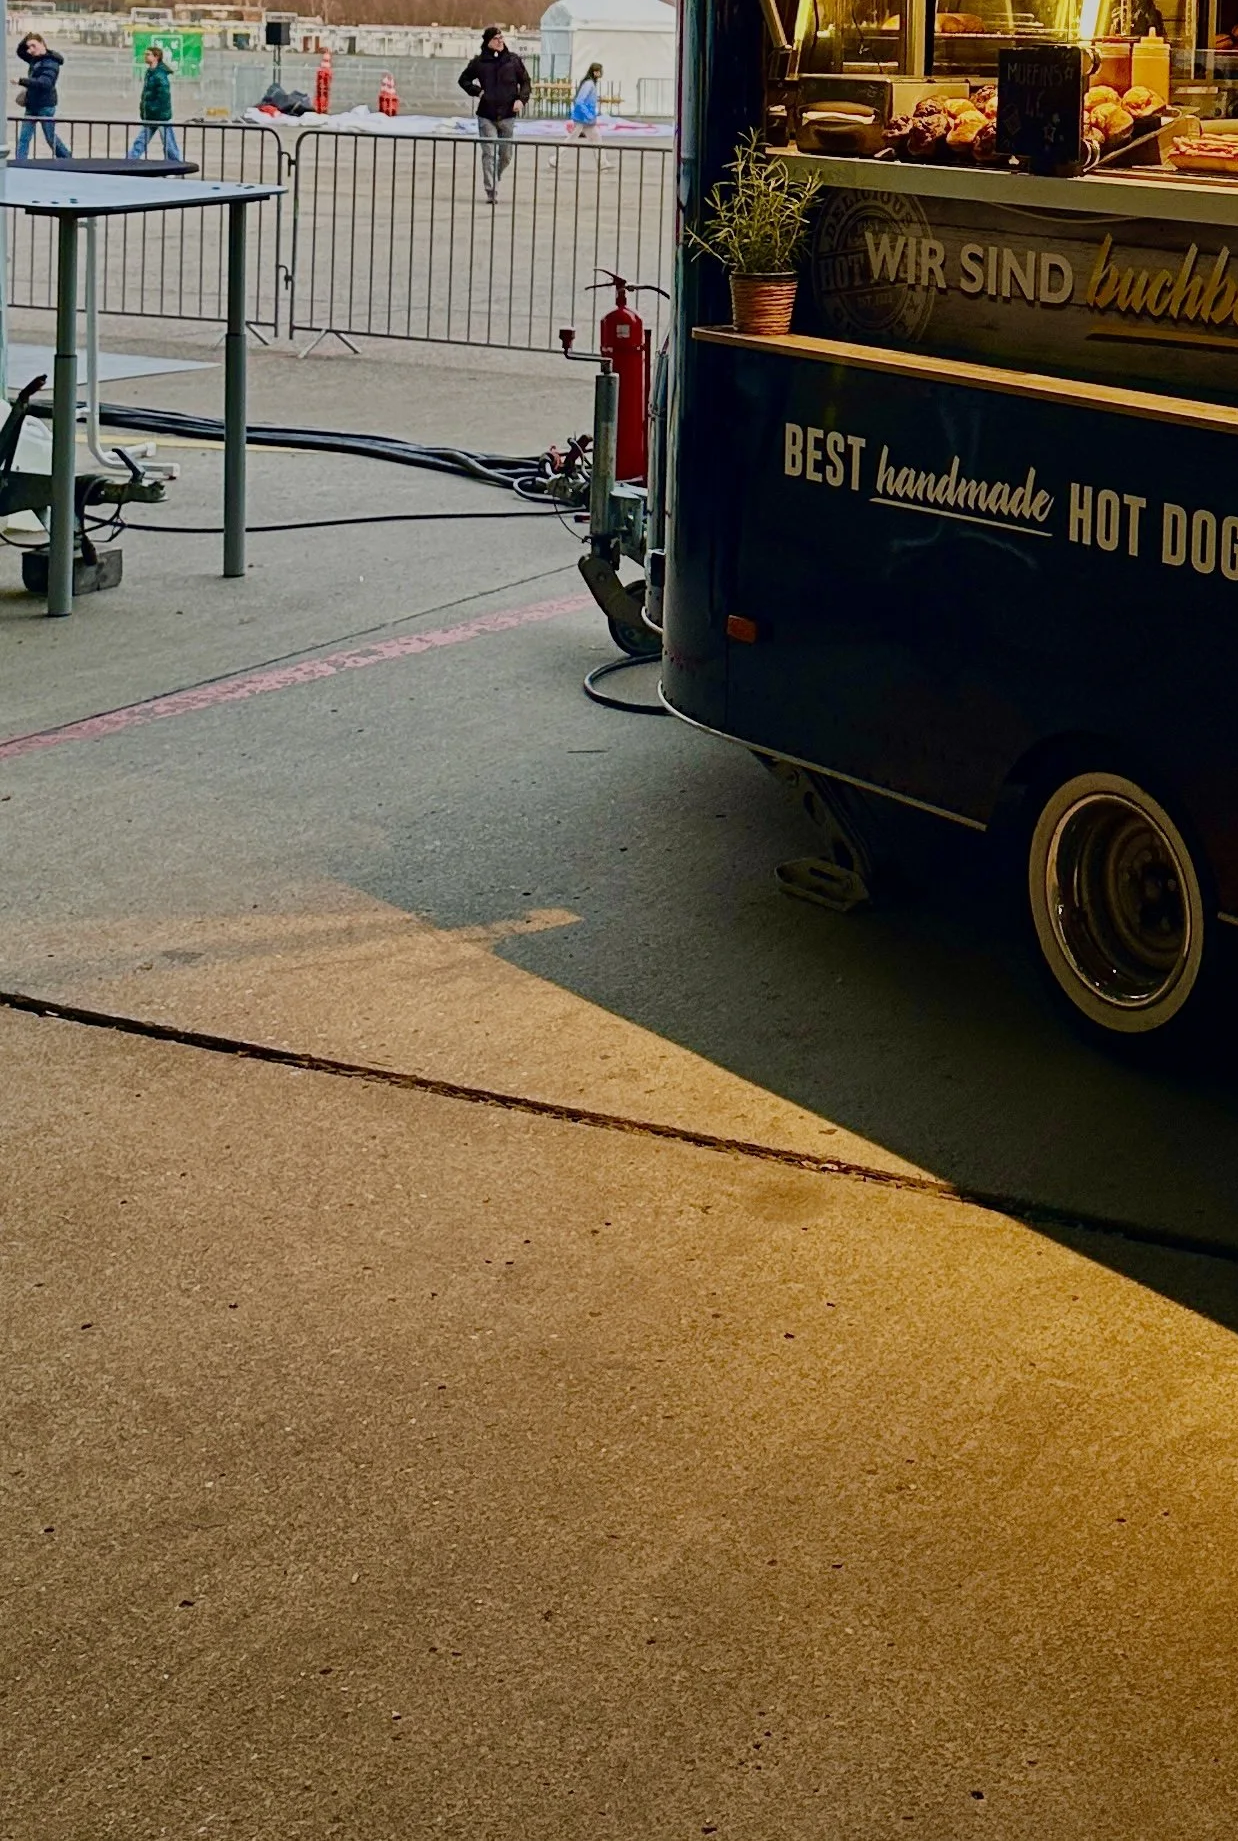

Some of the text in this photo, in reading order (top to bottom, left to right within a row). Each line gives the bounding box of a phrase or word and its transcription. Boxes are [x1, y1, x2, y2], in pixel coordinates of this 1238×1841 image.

[864, 231, 947, 289] WIR
[959, 242, 1074, 305] SIND
[784, 422, 866, 491] BEST
[876, 444, 1054, 522] handmade
[1069, 482, 1146, 557] HOT
